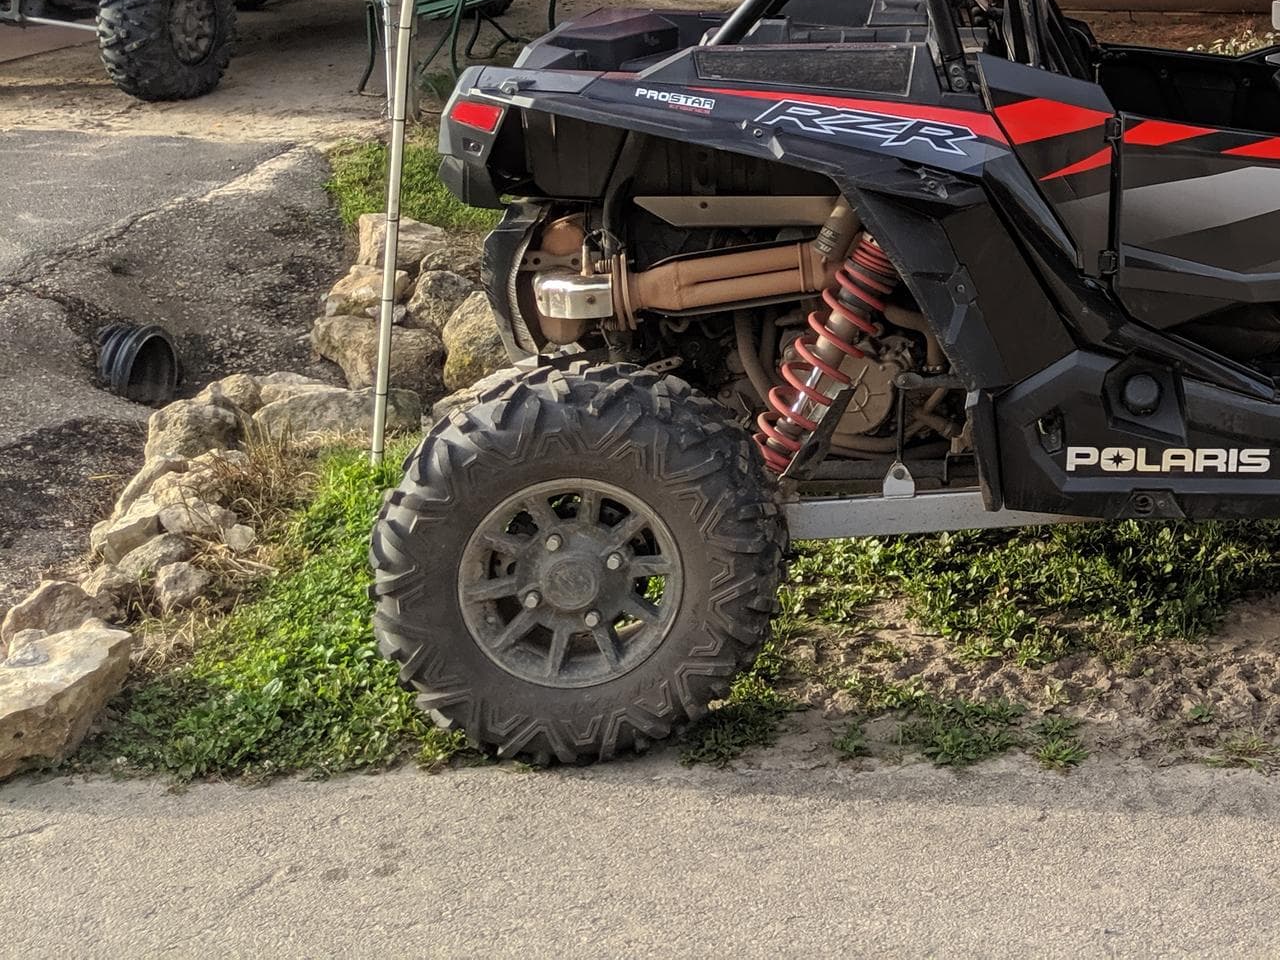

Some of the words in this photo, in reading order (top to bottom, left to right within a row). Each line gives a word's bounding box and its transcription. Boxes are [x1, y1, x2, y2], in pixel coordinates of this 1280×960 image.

[635, 87, 715, 110] PROSTAR
[753, 98, 978, 156] RZR
[1066, 446, 1271, 473] POLARIS
